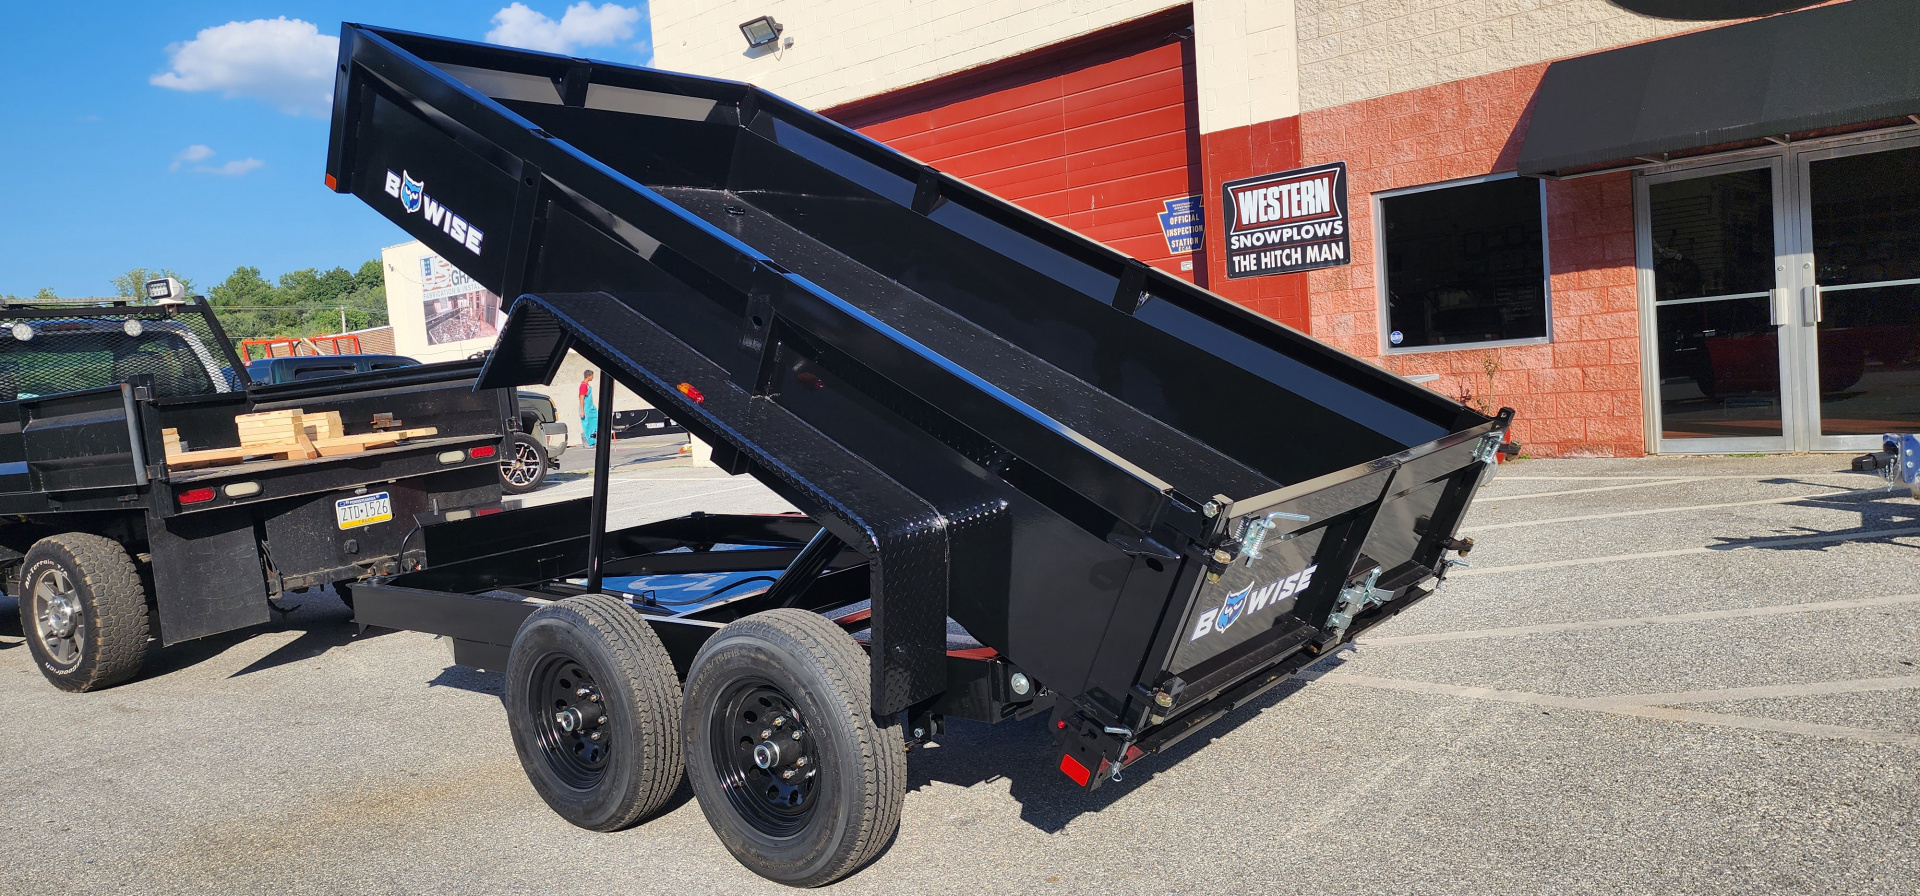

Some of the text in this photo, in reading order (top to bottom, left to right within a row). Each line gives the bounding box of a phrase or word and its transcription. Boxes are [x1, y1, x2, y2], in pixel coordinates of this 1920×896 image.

[1238, 177, 1331, 225] WESTERN
[1169, 213, 1200, 225] OFFICIAL
[1166, 224, 1203, 238] INSPECTION
[1230, 220, 1344, 250] SNOWPLOWS
[1171, 237, 1199, 249] STATION
[1232, 241, 1344, 273] THE HITCH MAN
[423, 287, 456, 299] FABRICATION
